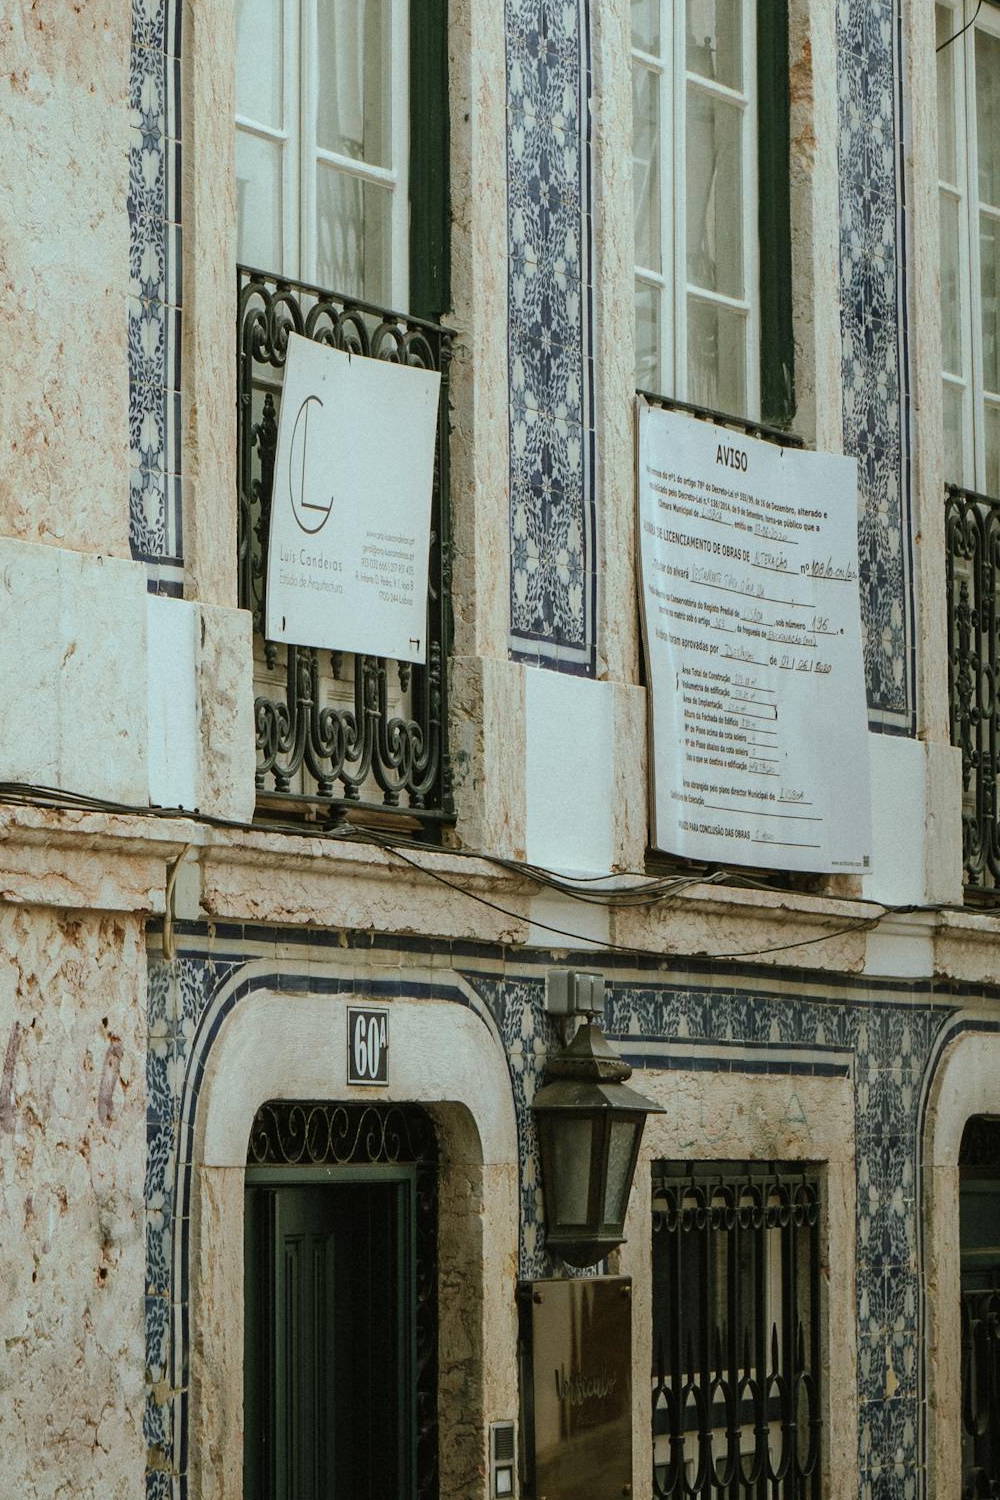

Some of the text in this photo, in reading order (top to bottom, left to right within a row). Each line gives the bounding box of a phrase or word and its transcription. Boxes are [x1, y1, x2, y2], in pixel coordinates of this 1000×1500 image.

[716, 444, 748, 472] AVISO
[668, 488, 678, 498] pelo
[678, 489, 702, 504] Decreto-Lei
[783, 518, 802, 531] público
[803, 524, 815, 532] que
[672, 503, 693, 517] Municipal
[683, 477, 697, 489] artigo
[711, 484, 734, 498] Decreto-Lei
[771, 502, 797, 516] Dezembro,
[797, 507, 822, 519] alterado
[663, 529, 712, 553] LICENCIAMENTO
[713, 542, 721, 555] DE
[722, 544, 741, 560] OBRAS
[742, 550, 750, 563] DE
[300, 548, 343, 572] Candeias
[673, 566, 689, 580] alvará
[698, 617, 711, 627] artigo
[703, 602, 719, 614] Registo
[785, 619, 806, 631] número
[681, 638, 709, 653] aprovadas
[710, 644, 719, 655] por
[769, 654, 777, 666] de
[708, 671, 731, 684] Construção
[747, 788, 769, 801] Municipal
[699, 823, 725, 837] CONCLUSÃO
[725, 827, 735, 838] DAS
[735, 829, 750, 840] OBRAS
[354, 1014, 387, 1079] 60A
